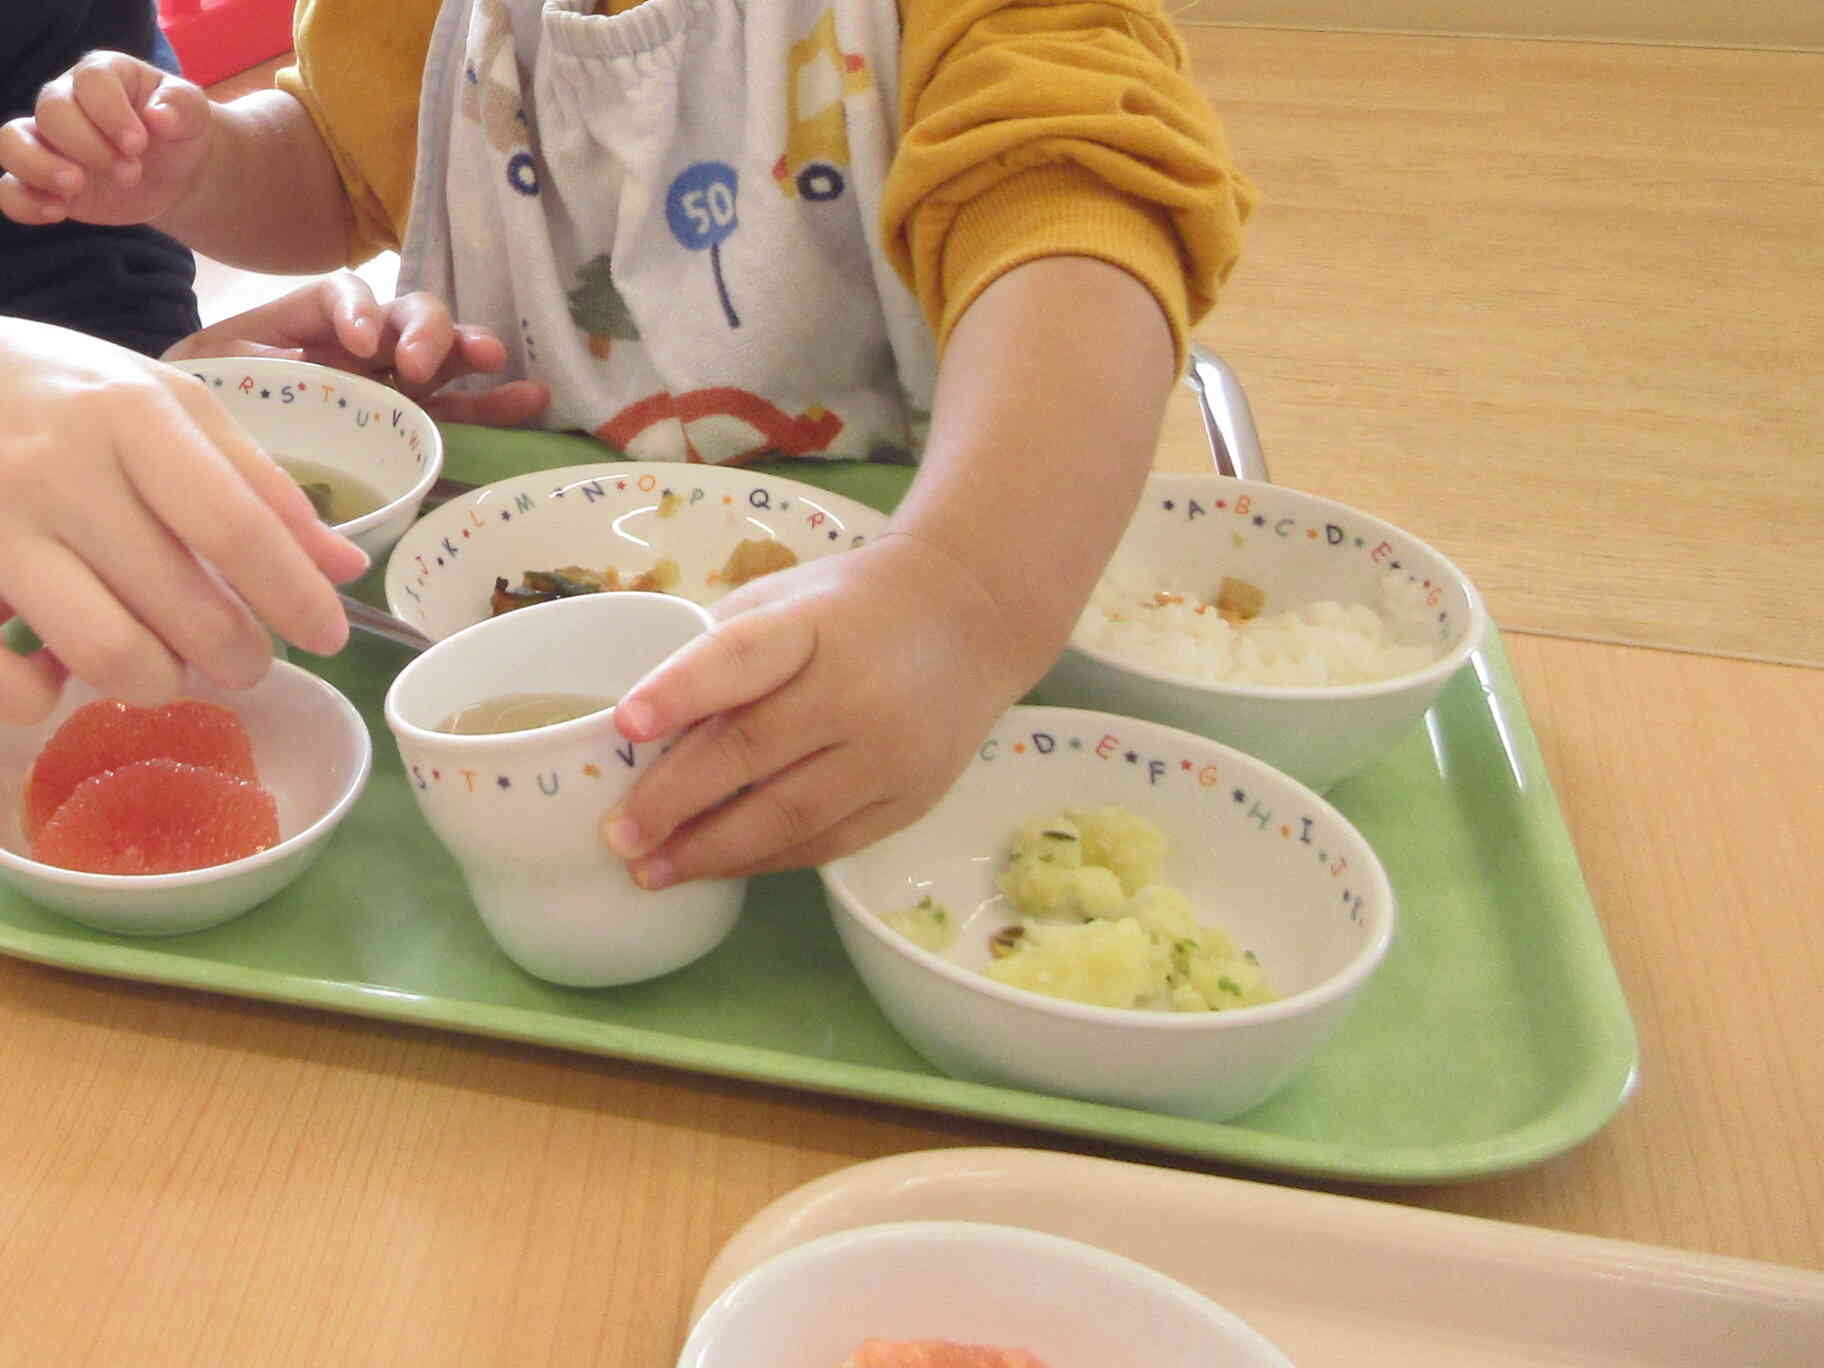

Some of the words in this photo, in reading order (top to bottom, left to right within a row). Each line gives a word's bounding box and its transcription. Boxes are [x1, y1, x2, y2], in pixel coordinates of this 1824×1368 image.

[682, 181, 734, 233] 50
[281, 386, 295, 404] S
[321, 385, 335, 403] T
[356, 408, 369, 427] U
[392, 409, 402, 427] V
[638, 474, 656, 492] O
[689, 488, 704, 505] P
[749, 489, 770, 510] Q
[1188, 499, 1205, 520] A
[1236, 495, 1250, 515] B
[1276, 518, 1294, 536] C
[1326, 524, 1344, 544] D
[1372, 541, 1392, 563] E
[460, 768, 477, 792] T
[538, 772, 559, 795] U
[616, 741, 635, 767] V
[1033, 733, 1054, 754] D
[1096, 734, 1120, 760] E
[1149, 761, 1166, 784] F
[1199, 765, 1217, 787] G
[1300, 817, 1312, 844] I
